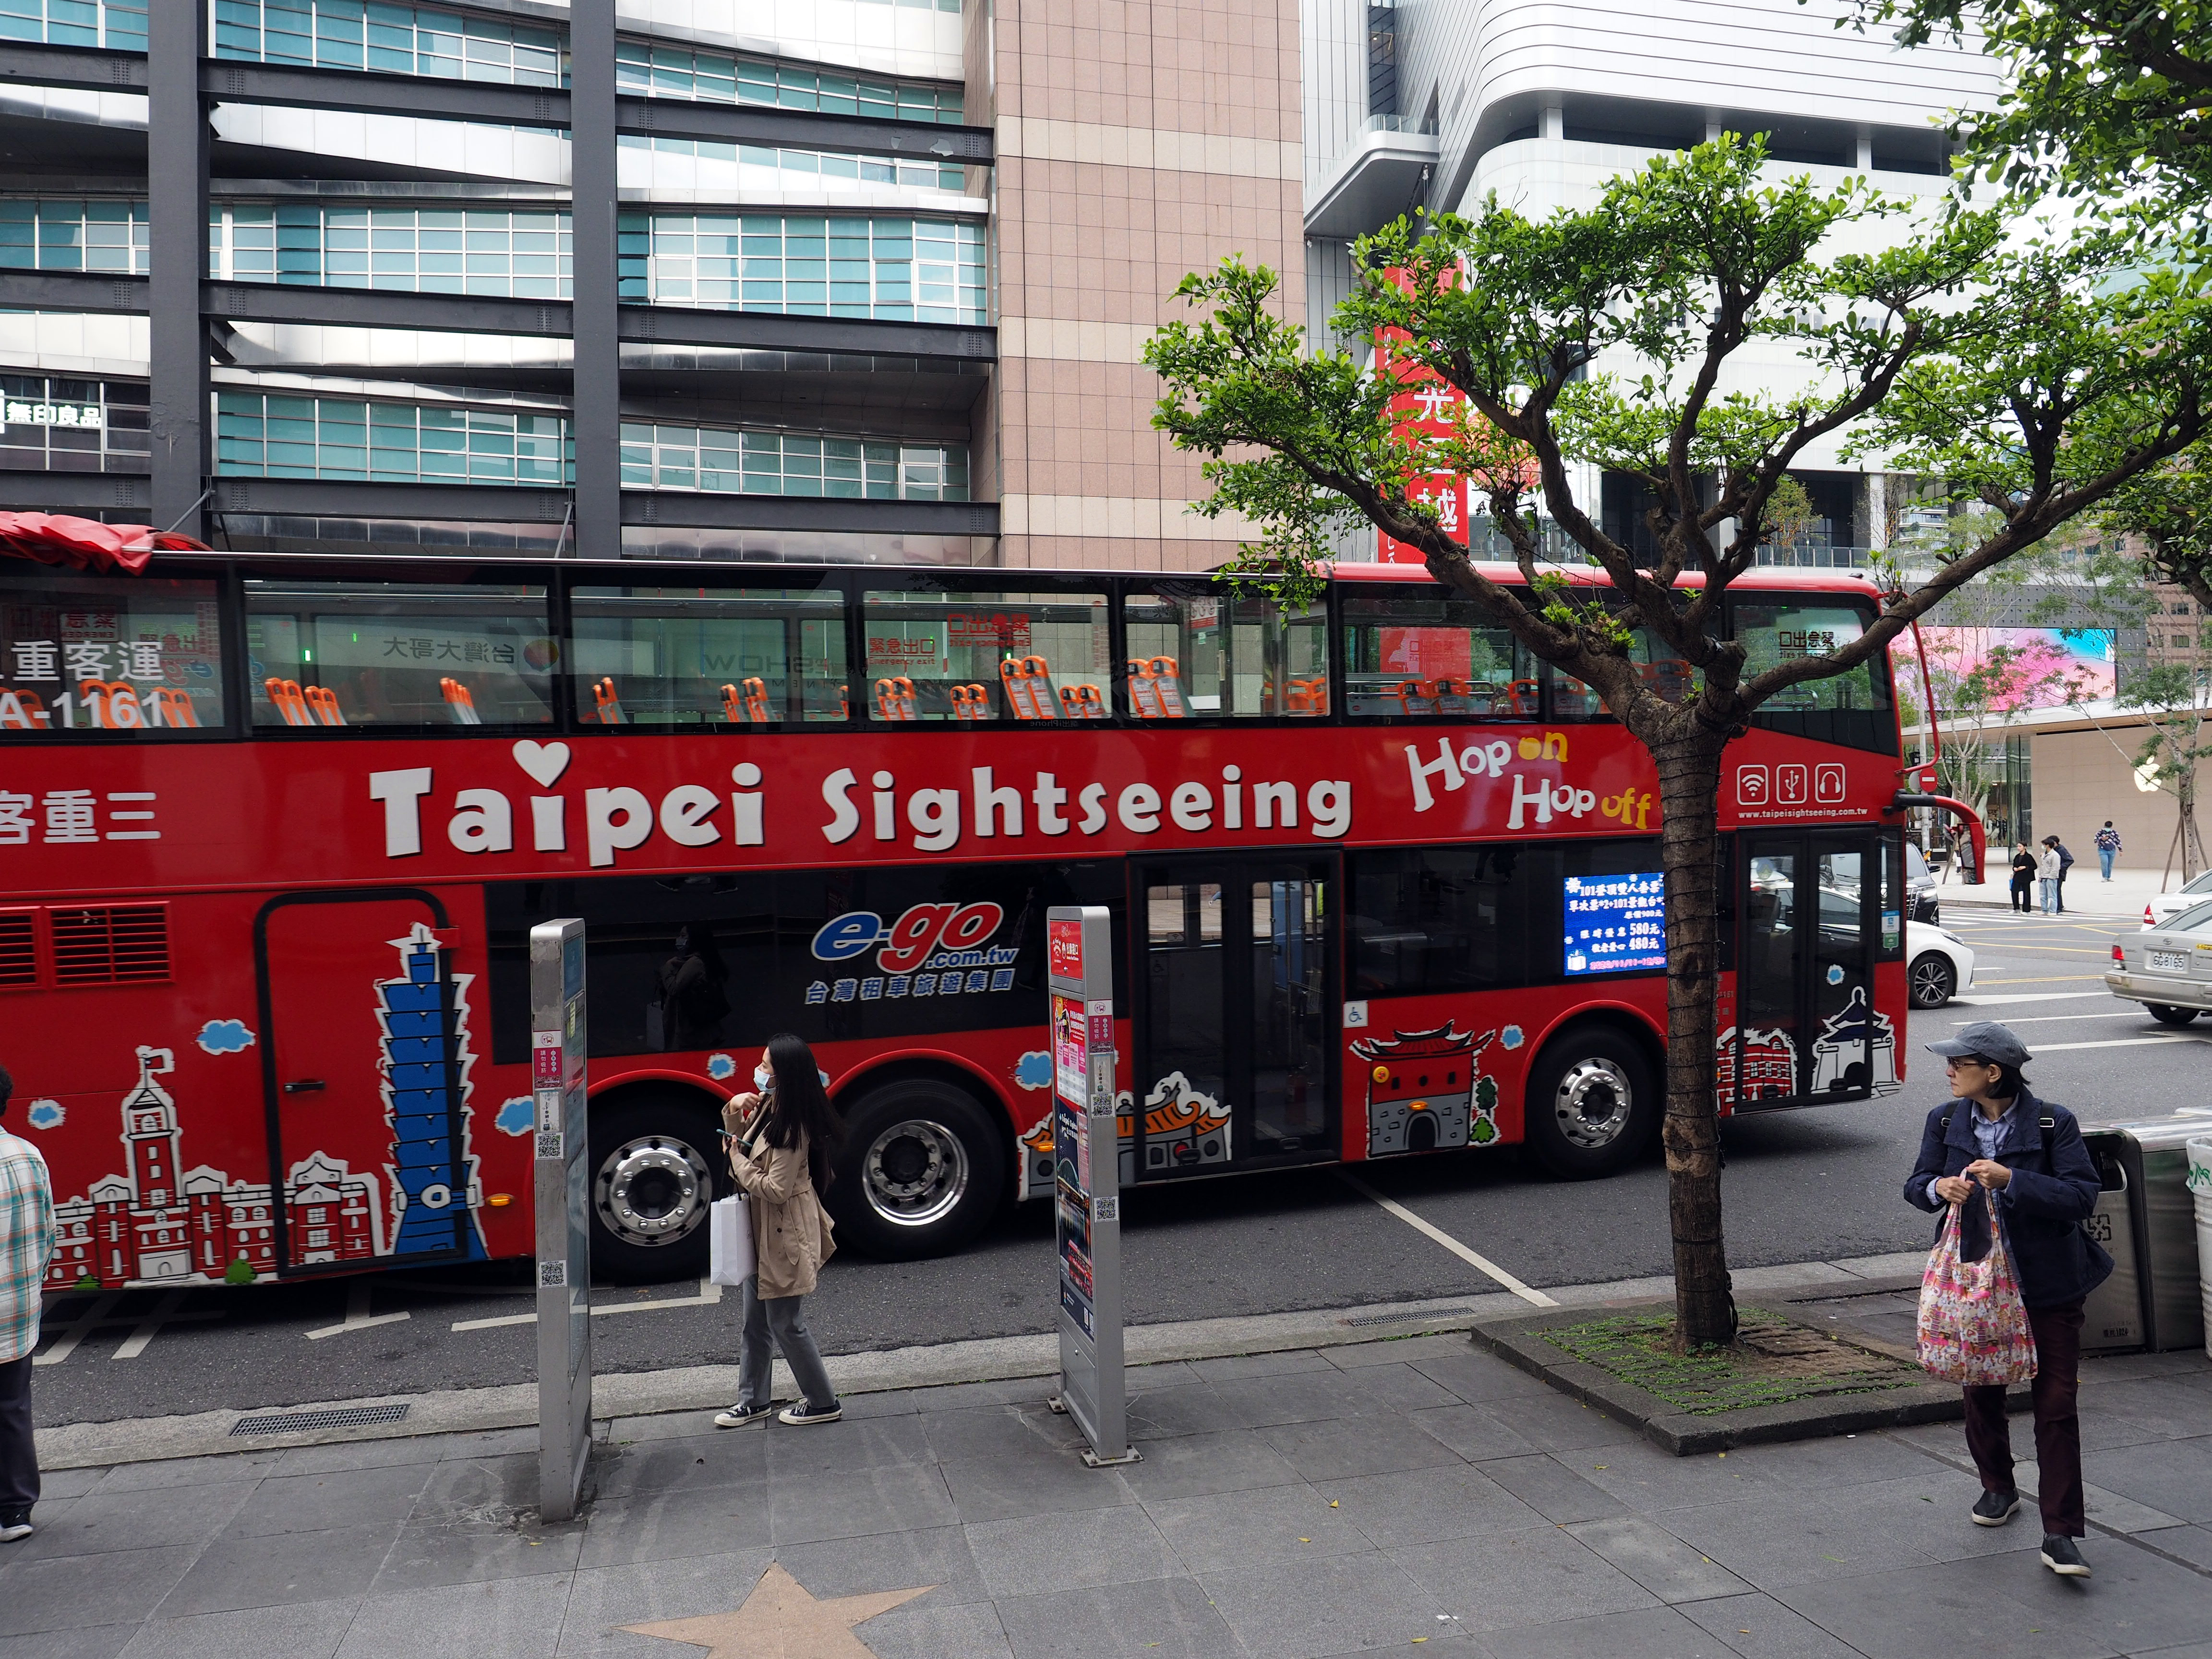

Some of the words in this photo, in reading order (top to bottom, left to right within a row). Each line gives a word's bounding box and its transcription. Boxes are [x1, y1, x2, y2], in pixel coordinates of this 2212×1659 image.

[7, 401, 102, 427] 無印良品
[0, 640, 165, 681] 重客運
[869, 637, 936, 654] 緊急出口
[1404, 737, 1512, 812] Hop
[1517, 732, 1568, 762] on
[370, 742, 765, 867] Taipei
[821, 764, 1352, 852] Sightseeing
[1506, 774, 1596, 829] Hop
[1601, 788, 1652, 829] off
[1738, 807, 1868, 818] www.taipeisightseeing.com.tw
[811, 901, 1004, 975] e-go
[925, 944, 1021, 969] .com.tw
[805, 968, 1016, 1005] 台灣租車旅遊集團
